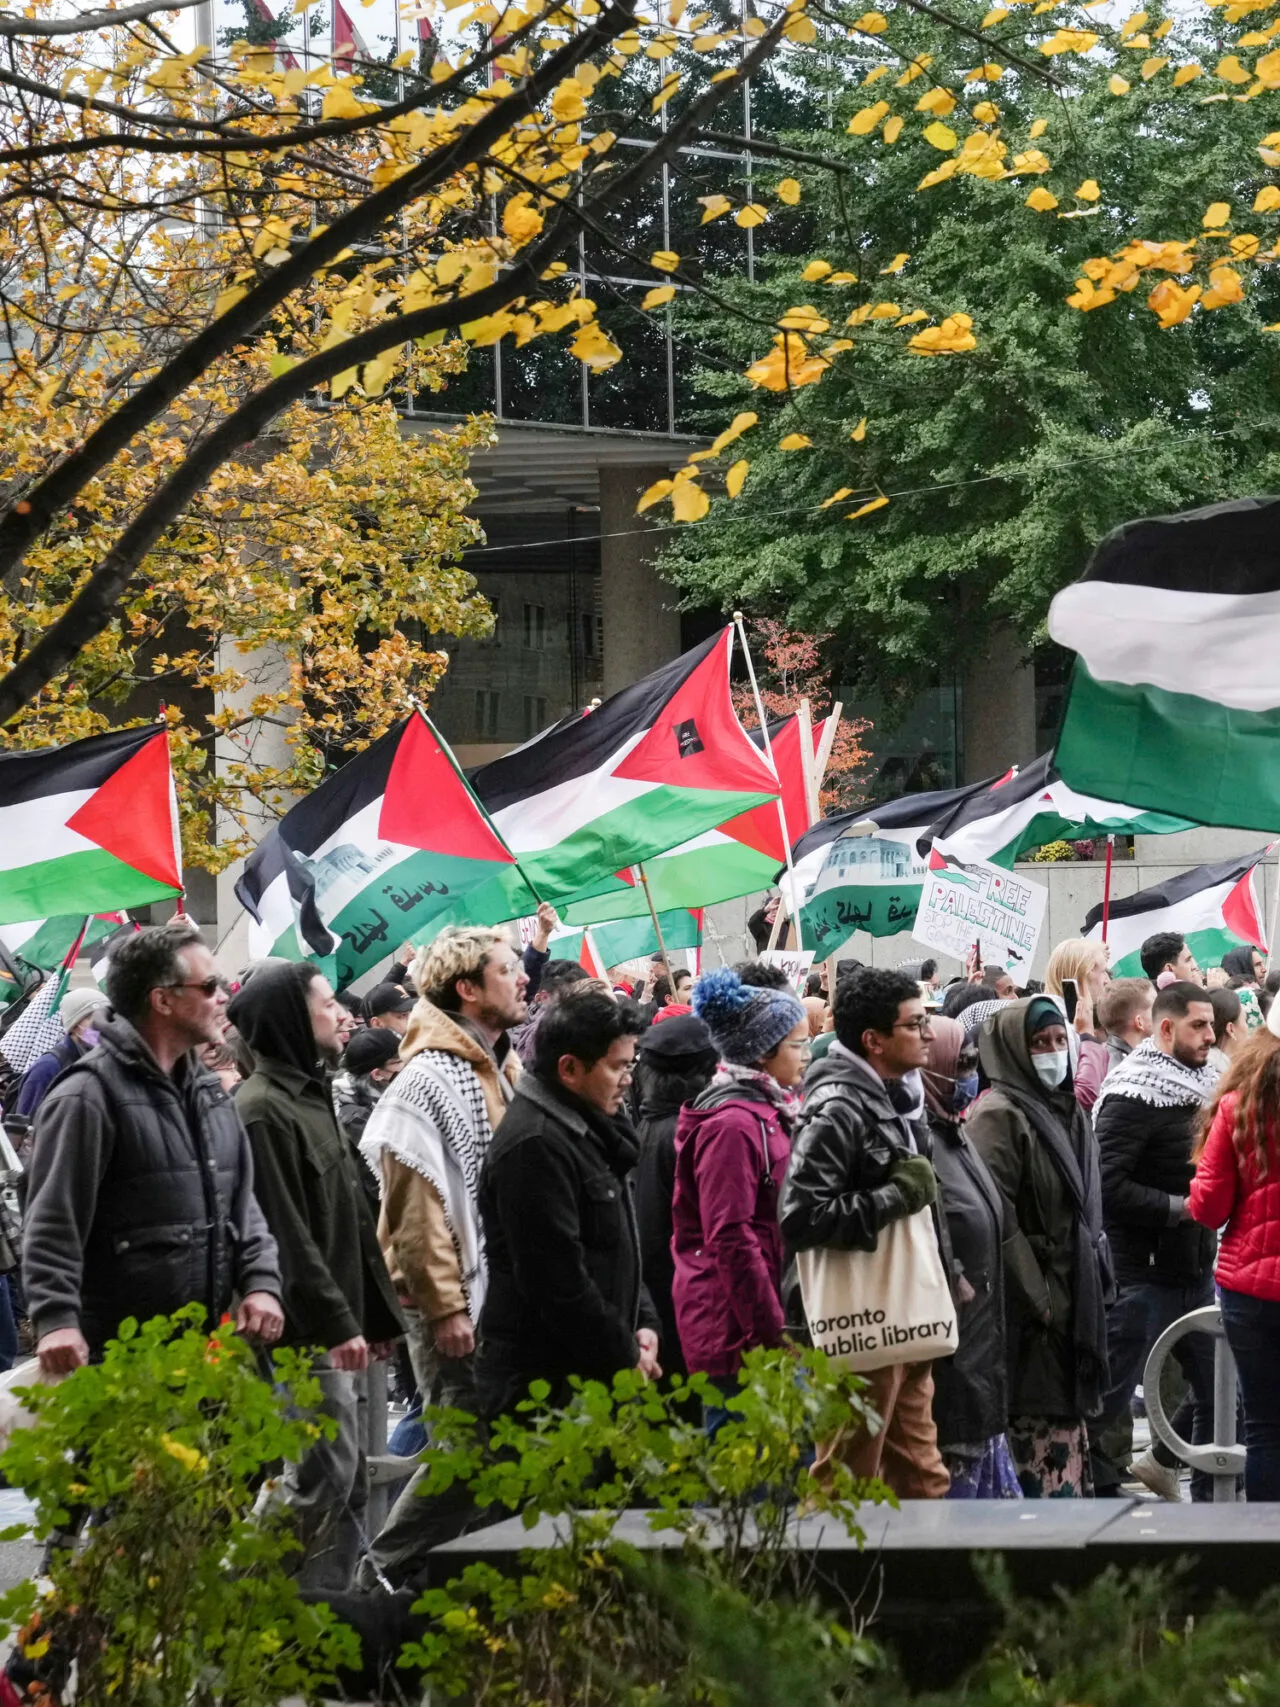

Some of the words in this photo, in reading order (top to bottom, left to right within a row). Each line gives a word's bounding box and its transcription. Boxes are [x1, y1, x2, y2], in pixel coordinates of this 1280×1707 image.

[977, 868, 1032, 917] FREE
[924, 909, 953, 929] STOP
[955, 919, 975, 938] THE
[928, 881, 1036, 951] PALESTINE
[810, 1308, 886, 1336] toronto
[818, 1332, 877, 1358] ublic
[881, 1320, 953, 1347] library
